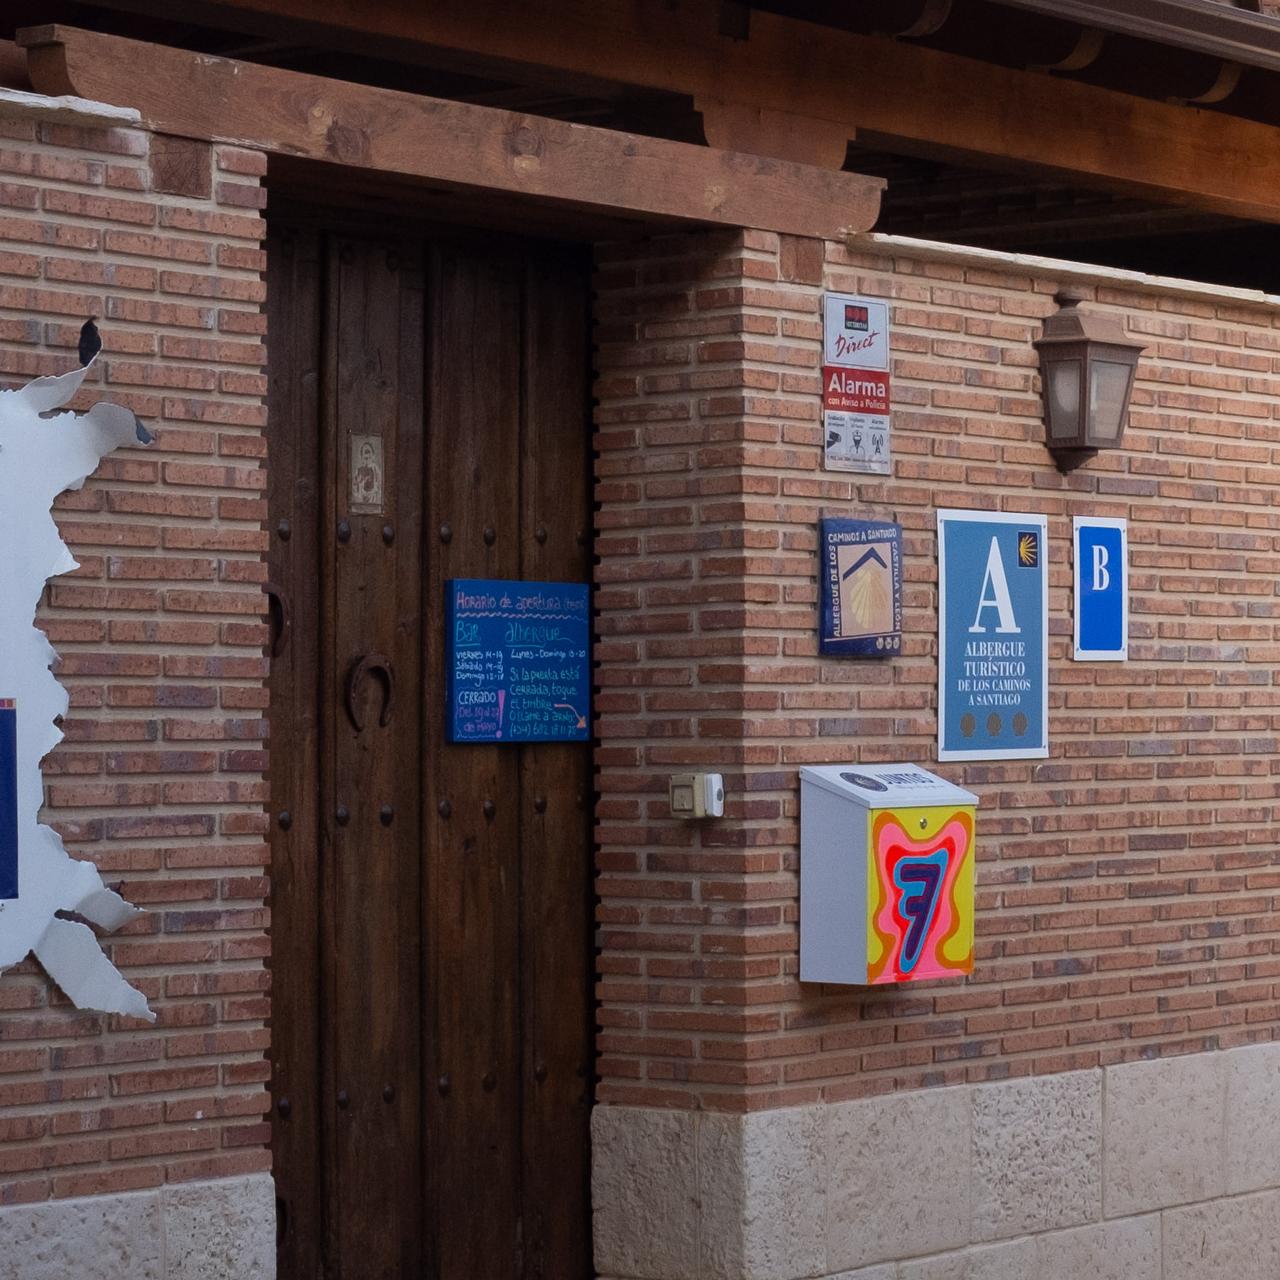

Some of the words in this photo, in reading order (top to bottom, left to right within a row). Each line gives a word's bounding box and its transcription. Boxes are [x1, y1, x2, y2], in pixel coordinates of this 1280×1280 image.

[835, 330, 880, 358] Direct
[828, 372, 886, 398] Alarma
[828, 397, 840, 405] con
[841, 397, 859, 407] Aviso
[827, 532, 860, 544] CAMINOS
[861, 531, 867, 542] A
[828, 545, 837, 566] LOS
[892, 541, 900, 590] CASTILLA
[830, 567, 839, 581] DE
[1092, 545, 1110, 590] B
[968, 536, 1021, 634] A
[500, 592, 513, 609] de
[831, 585, 840, 637] ALBERGUE
[964, 641, 1026, 657] ALBERGUE
[963, 657, 1026, 677] TURÍSTICO
[958, 680, 971, 692] DE
[973, 680, 990, 692] LOS
[992, 680, 1031, 692] CAMINOS
[968, 694, 975, 706] A
[976, 693, 1021, 706] SANTIAGO
